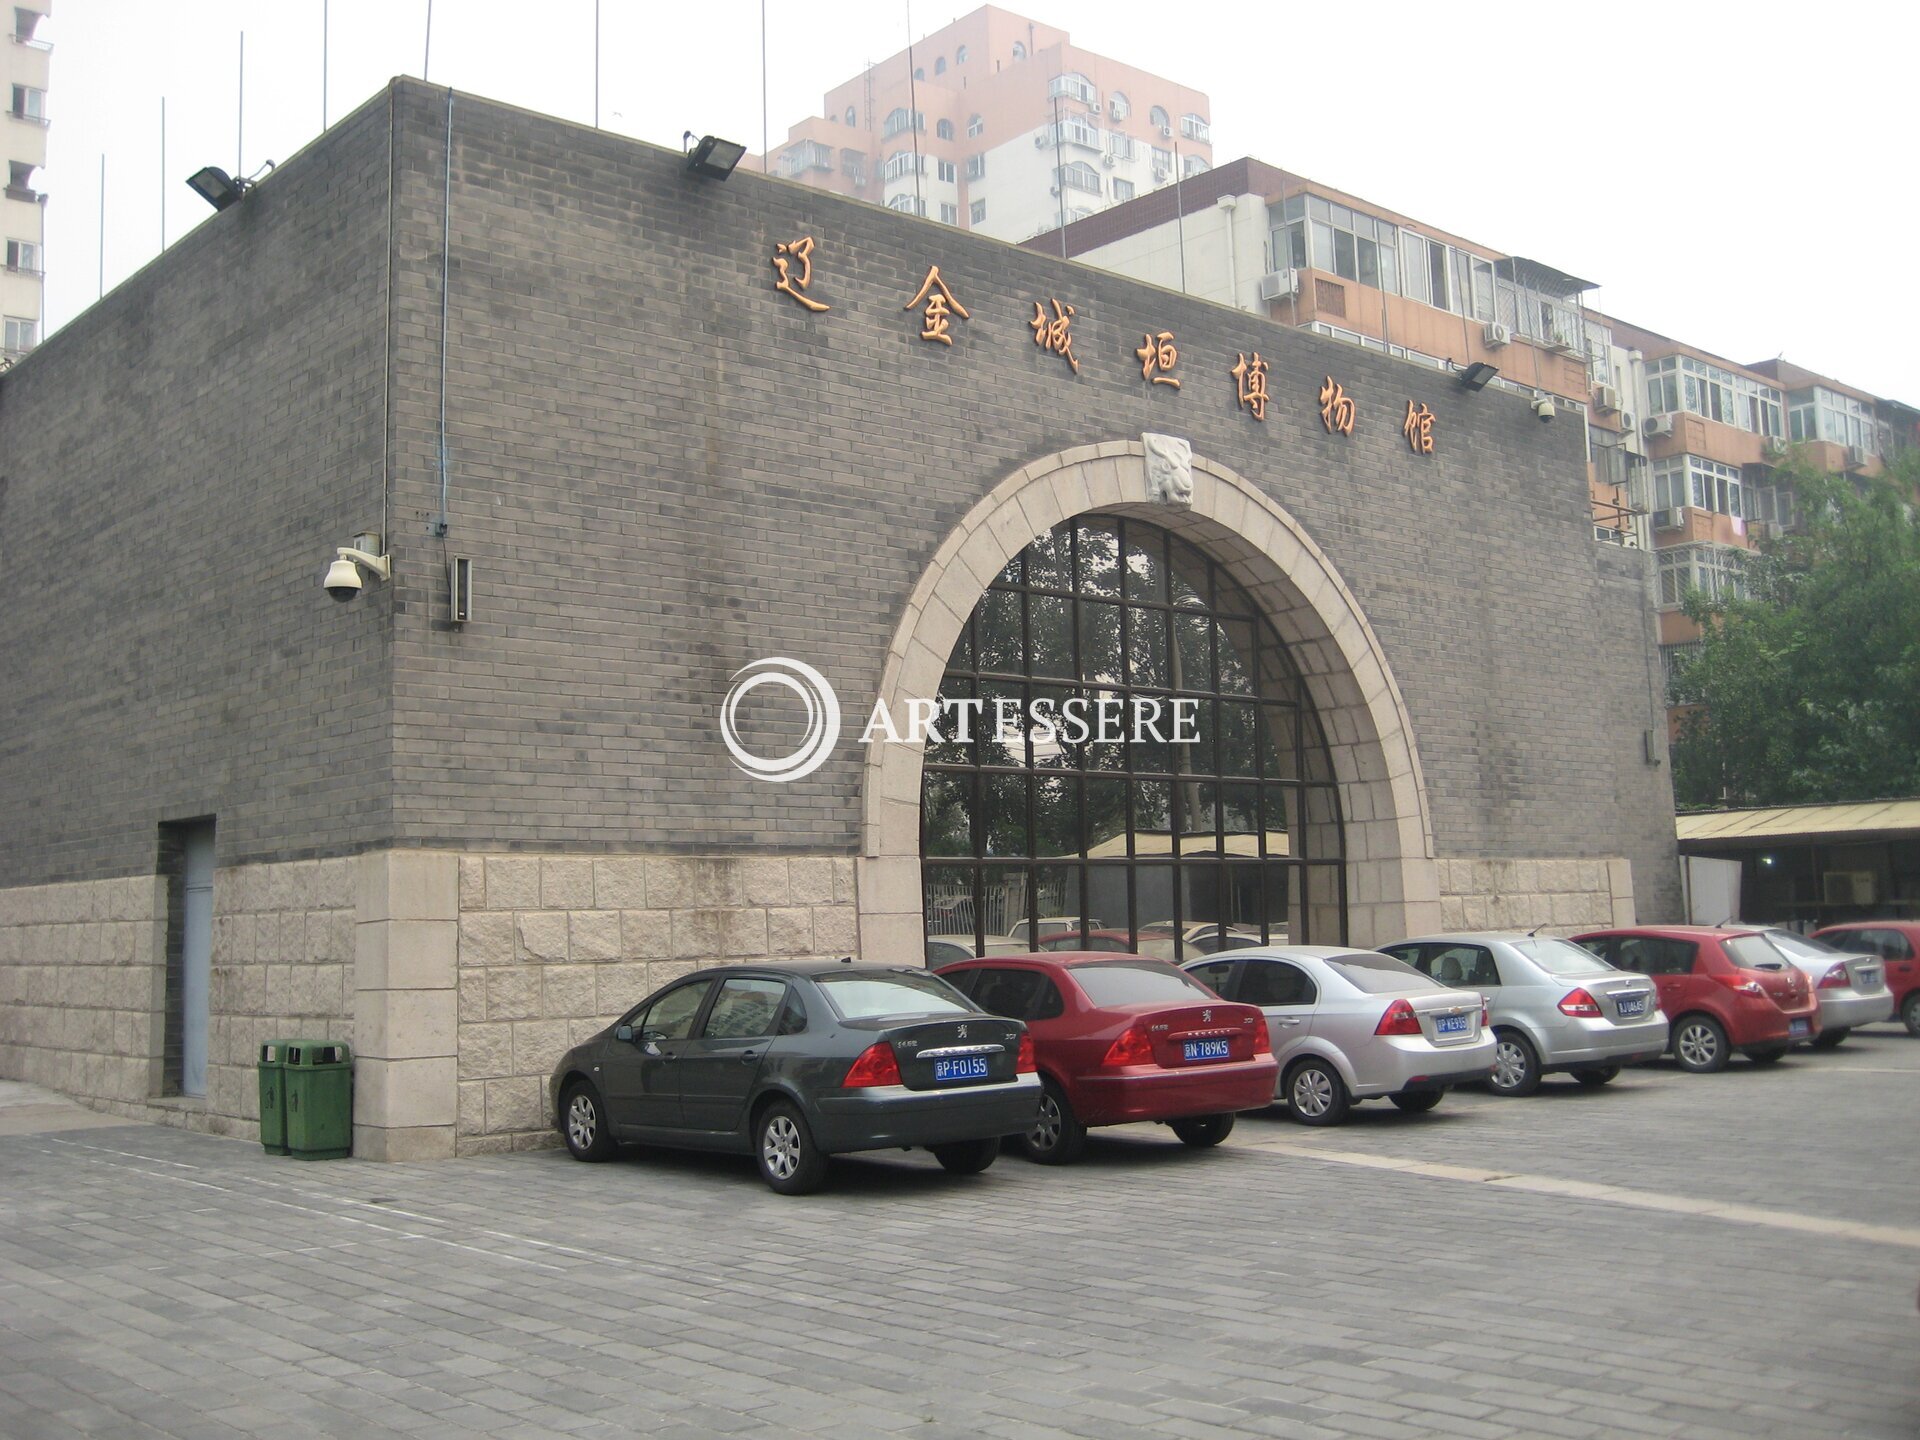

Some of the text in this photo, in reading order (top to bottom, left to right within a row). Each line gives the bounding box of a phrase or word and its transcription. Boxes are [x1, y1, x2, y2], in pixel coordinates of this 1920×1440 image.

[772, 236, 1436, 454] 辽金城垣博物馆
[936, 1057, 987, 1078] 京P·F0155
